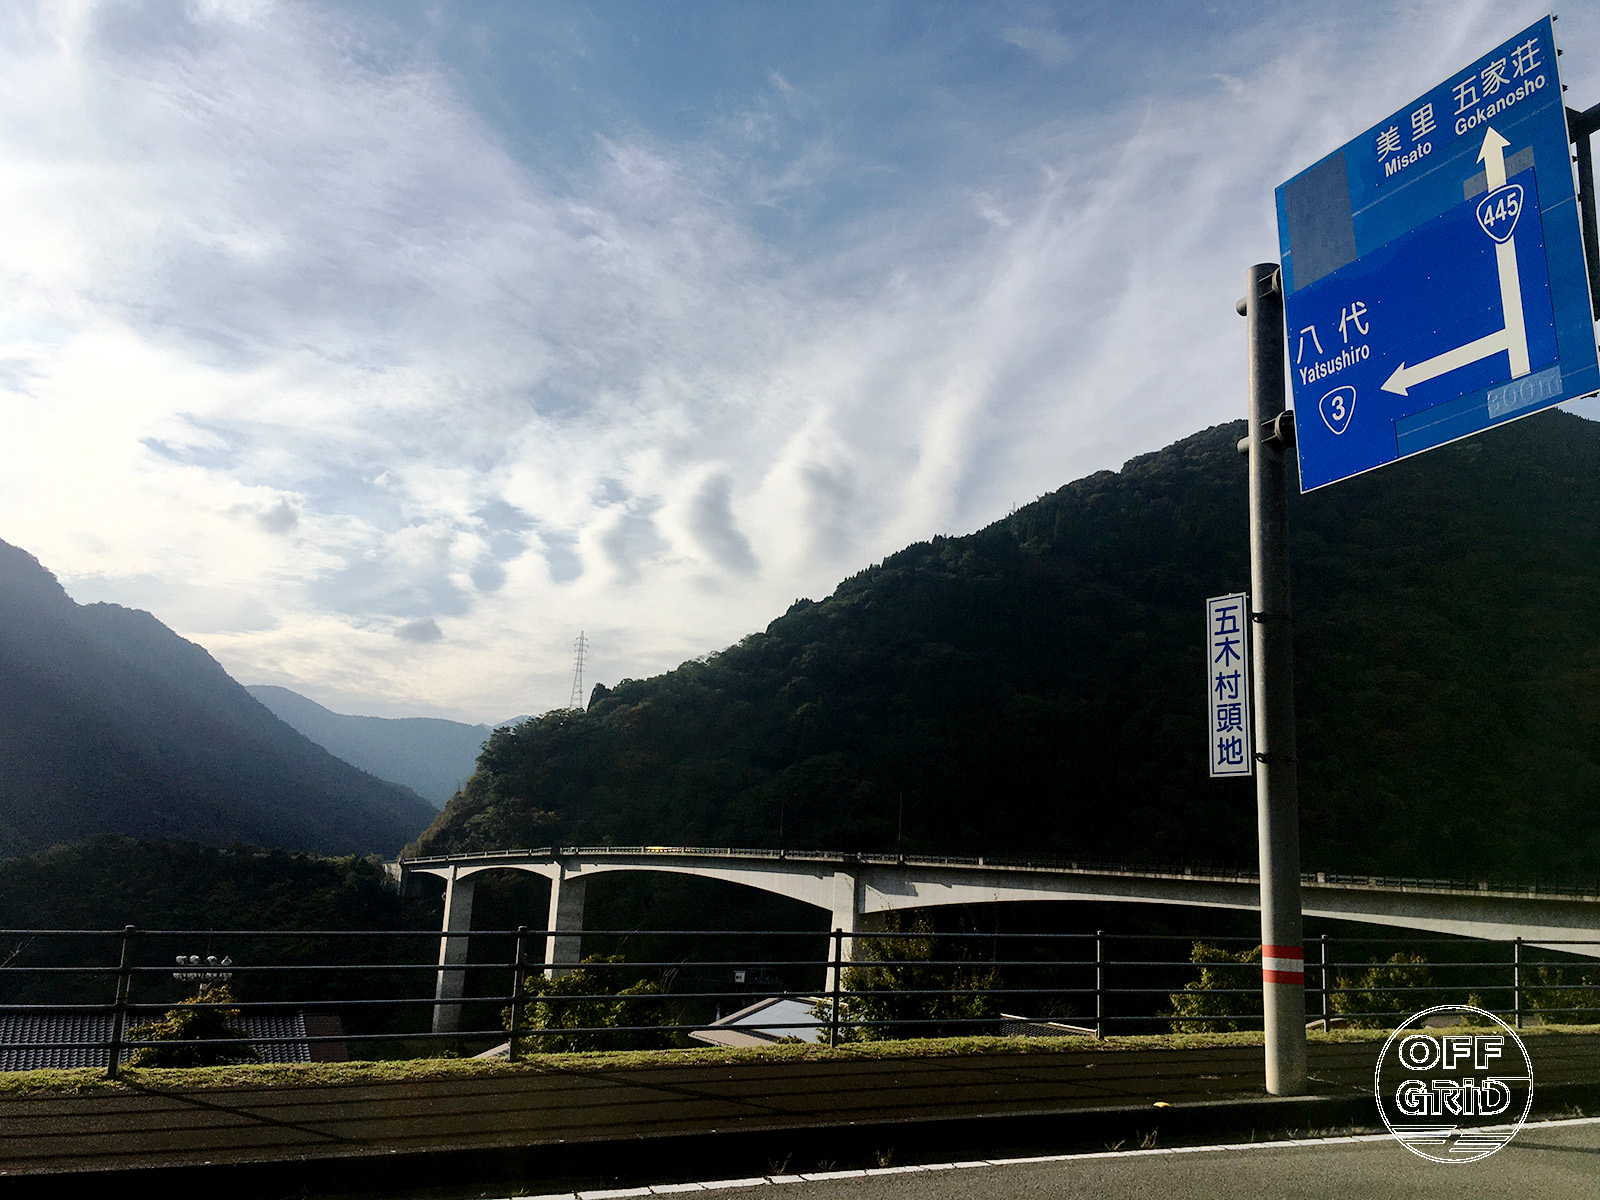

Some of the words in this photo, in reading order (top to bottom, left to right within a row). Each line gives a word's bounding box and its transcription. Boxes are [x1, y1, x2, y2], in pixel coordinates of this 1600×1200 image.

[1451, 37, 1542, 116] 五家荘
[1454, 73, 1546, 136] Gokanosho
[1376, 103, 1437, 163] 美里
[1384, 141, 1432, 178] Misato
[1482, 192, 1519, 228] 445
[1296, 301, 1370, 365] 八代
[1299, 344, 1370, 386] Yatsushiro
[1331, 395, 1346, 422] 3
[1214, 605, 1243, 765] 五木村頭地
